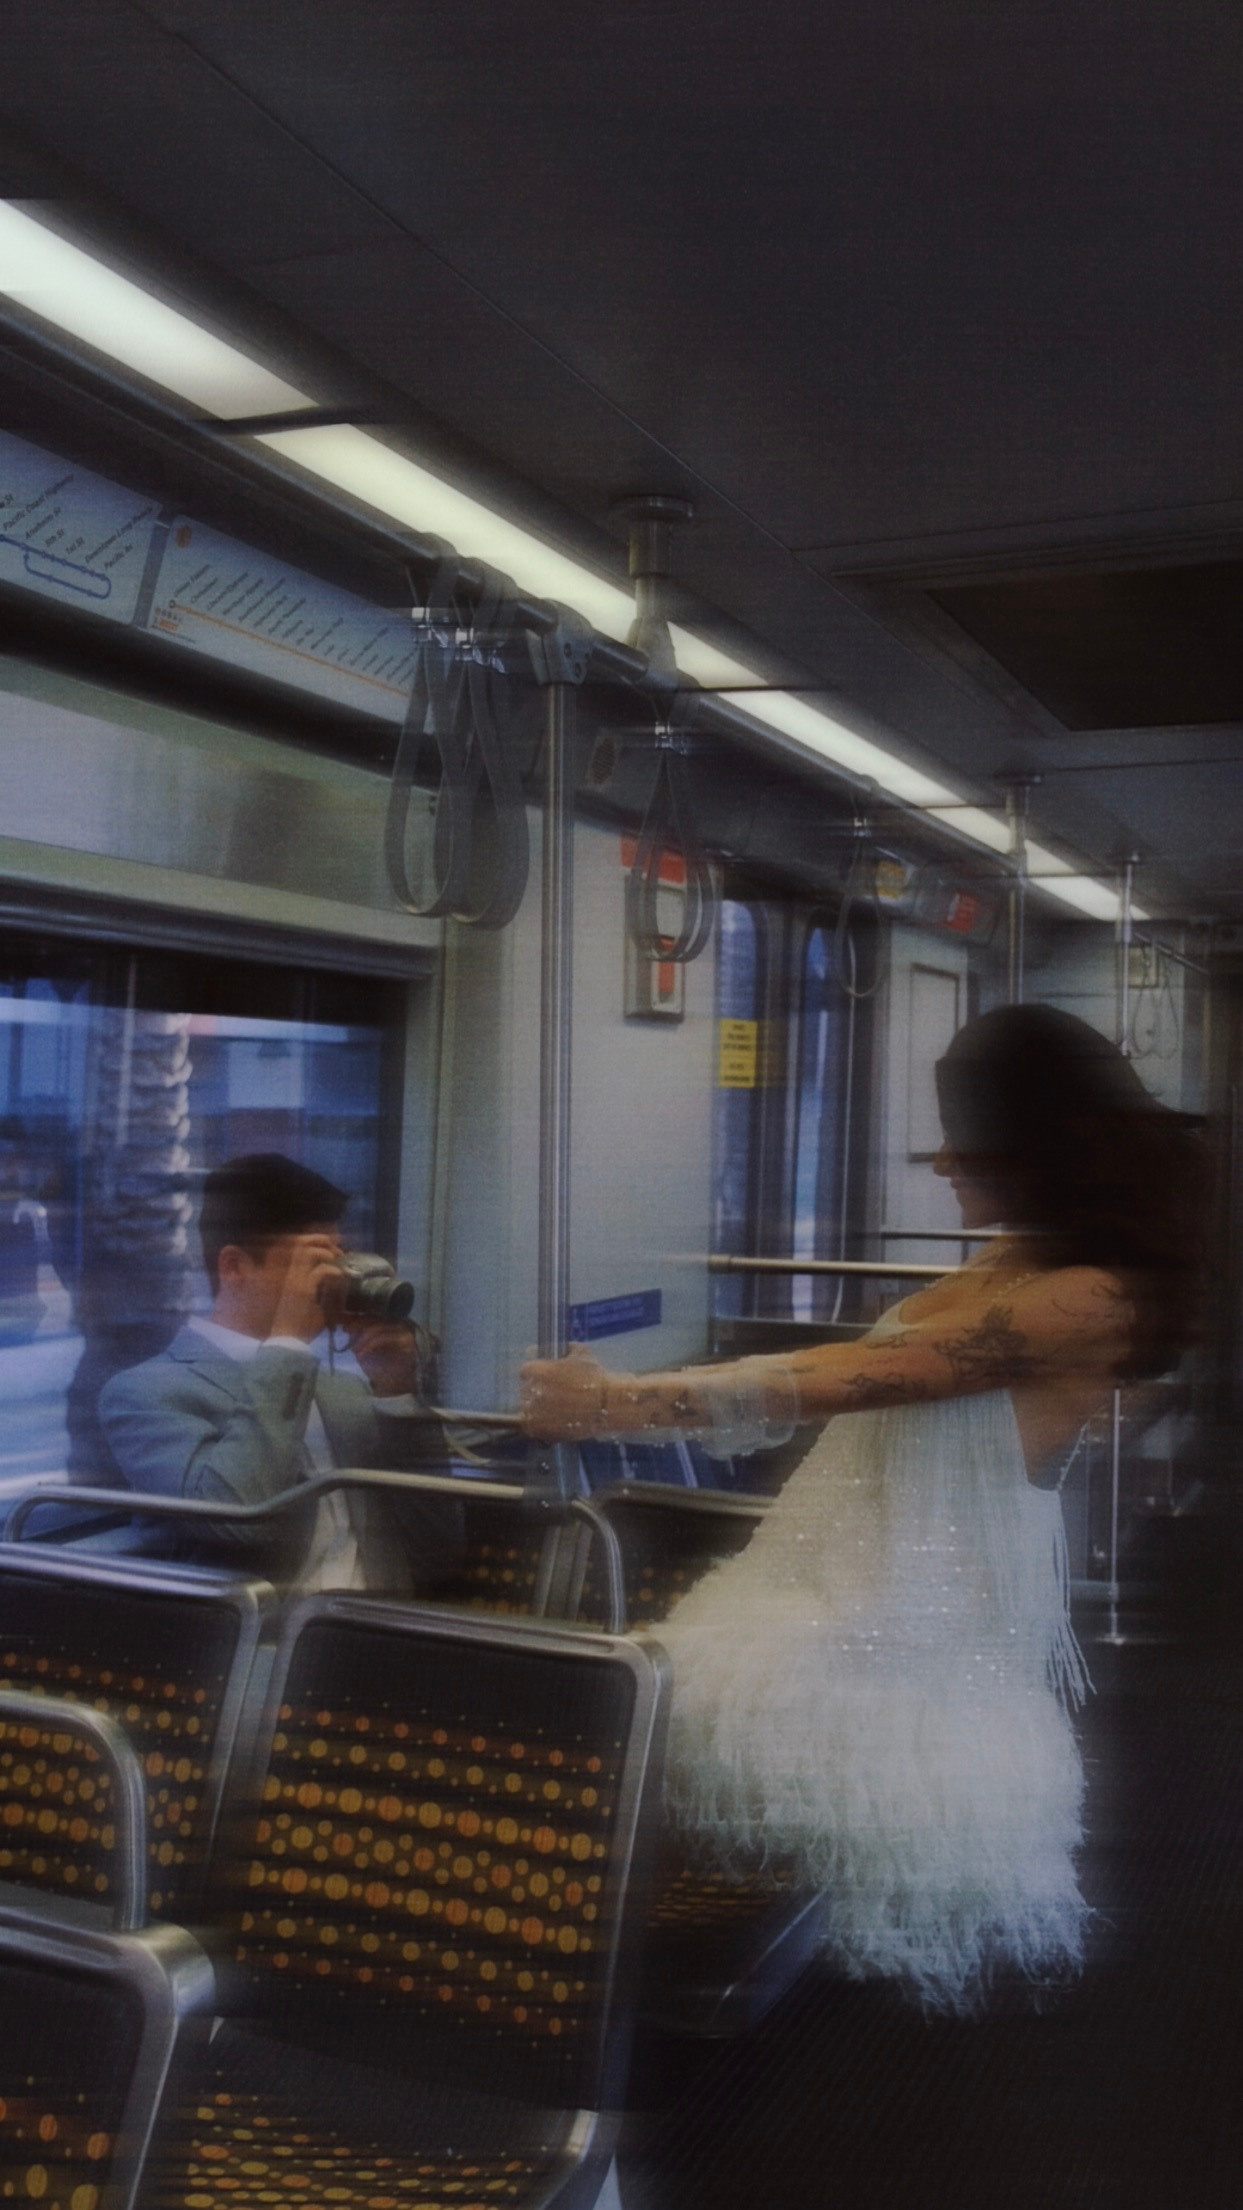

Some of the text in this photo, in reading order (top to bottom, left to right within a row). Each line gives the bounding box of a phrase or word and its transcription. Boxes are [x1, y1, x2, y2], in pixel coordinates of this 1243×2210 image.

[3, 510, 26, 531] Pacific
[26, 495, 45, 511] Coast
[25, 513, 54, 539] Anaheim
[75, 536, 86, 547] St
[104, 551, 125, 571] Pacific
